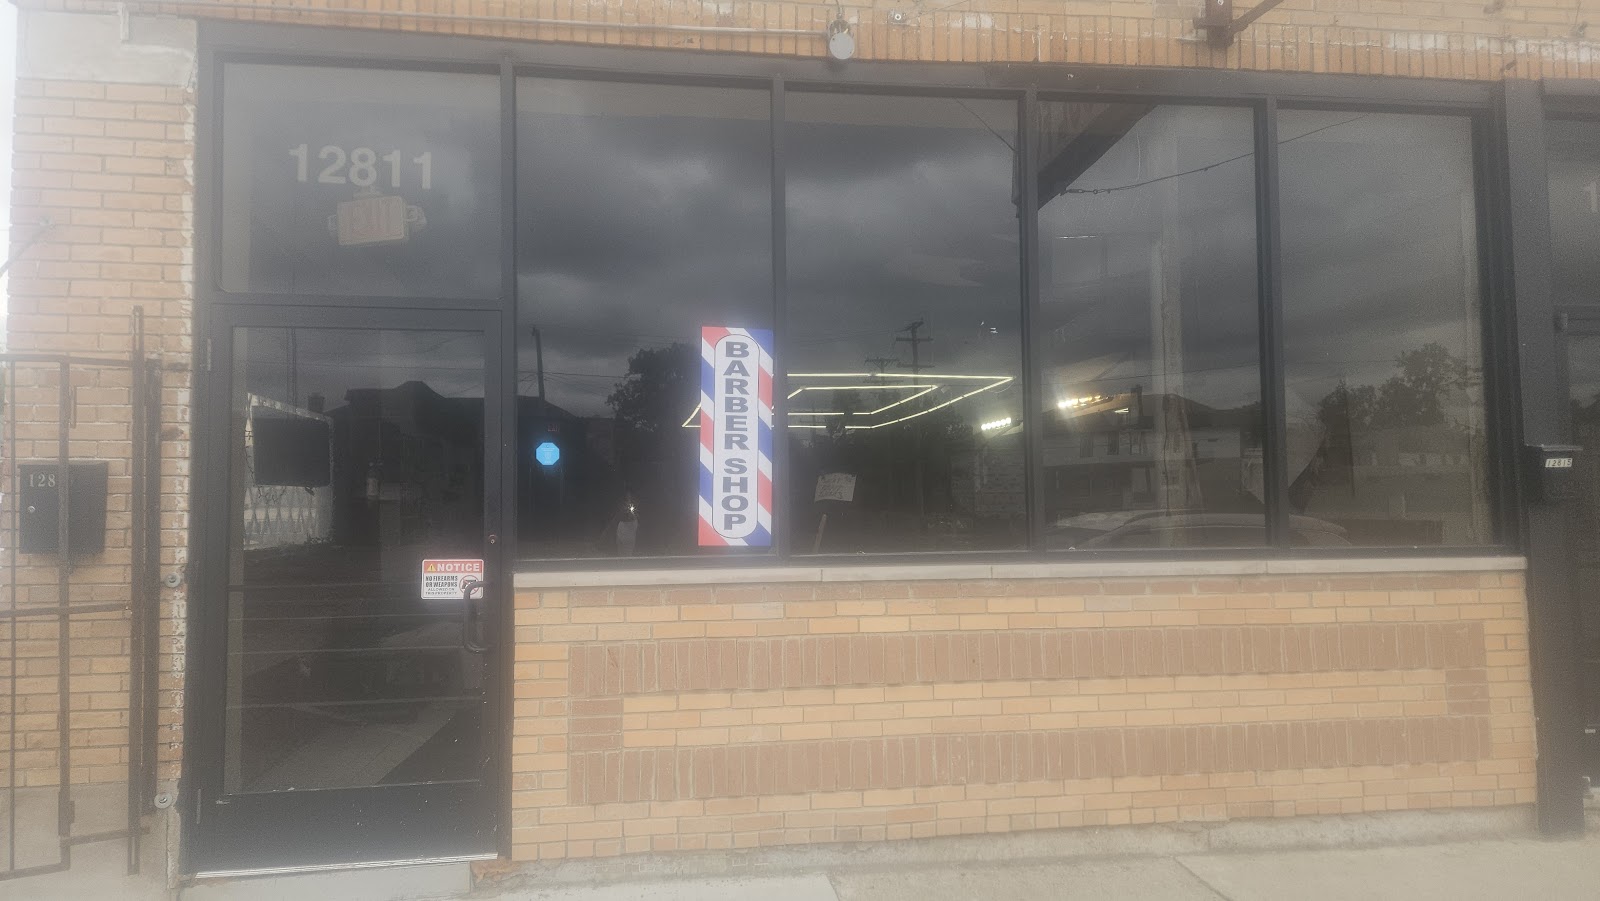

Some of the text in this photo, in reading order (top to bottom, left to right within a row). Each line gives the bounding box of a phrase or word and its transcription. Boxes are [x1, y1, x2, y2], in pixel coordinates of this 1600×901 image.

[288, 143, 432, 190] 12811
[721, 341, 751, 531] BARBER SHOP
[1547, 458, 1572, 467] 12815
[437, 563, 480, 572] NOTICE
